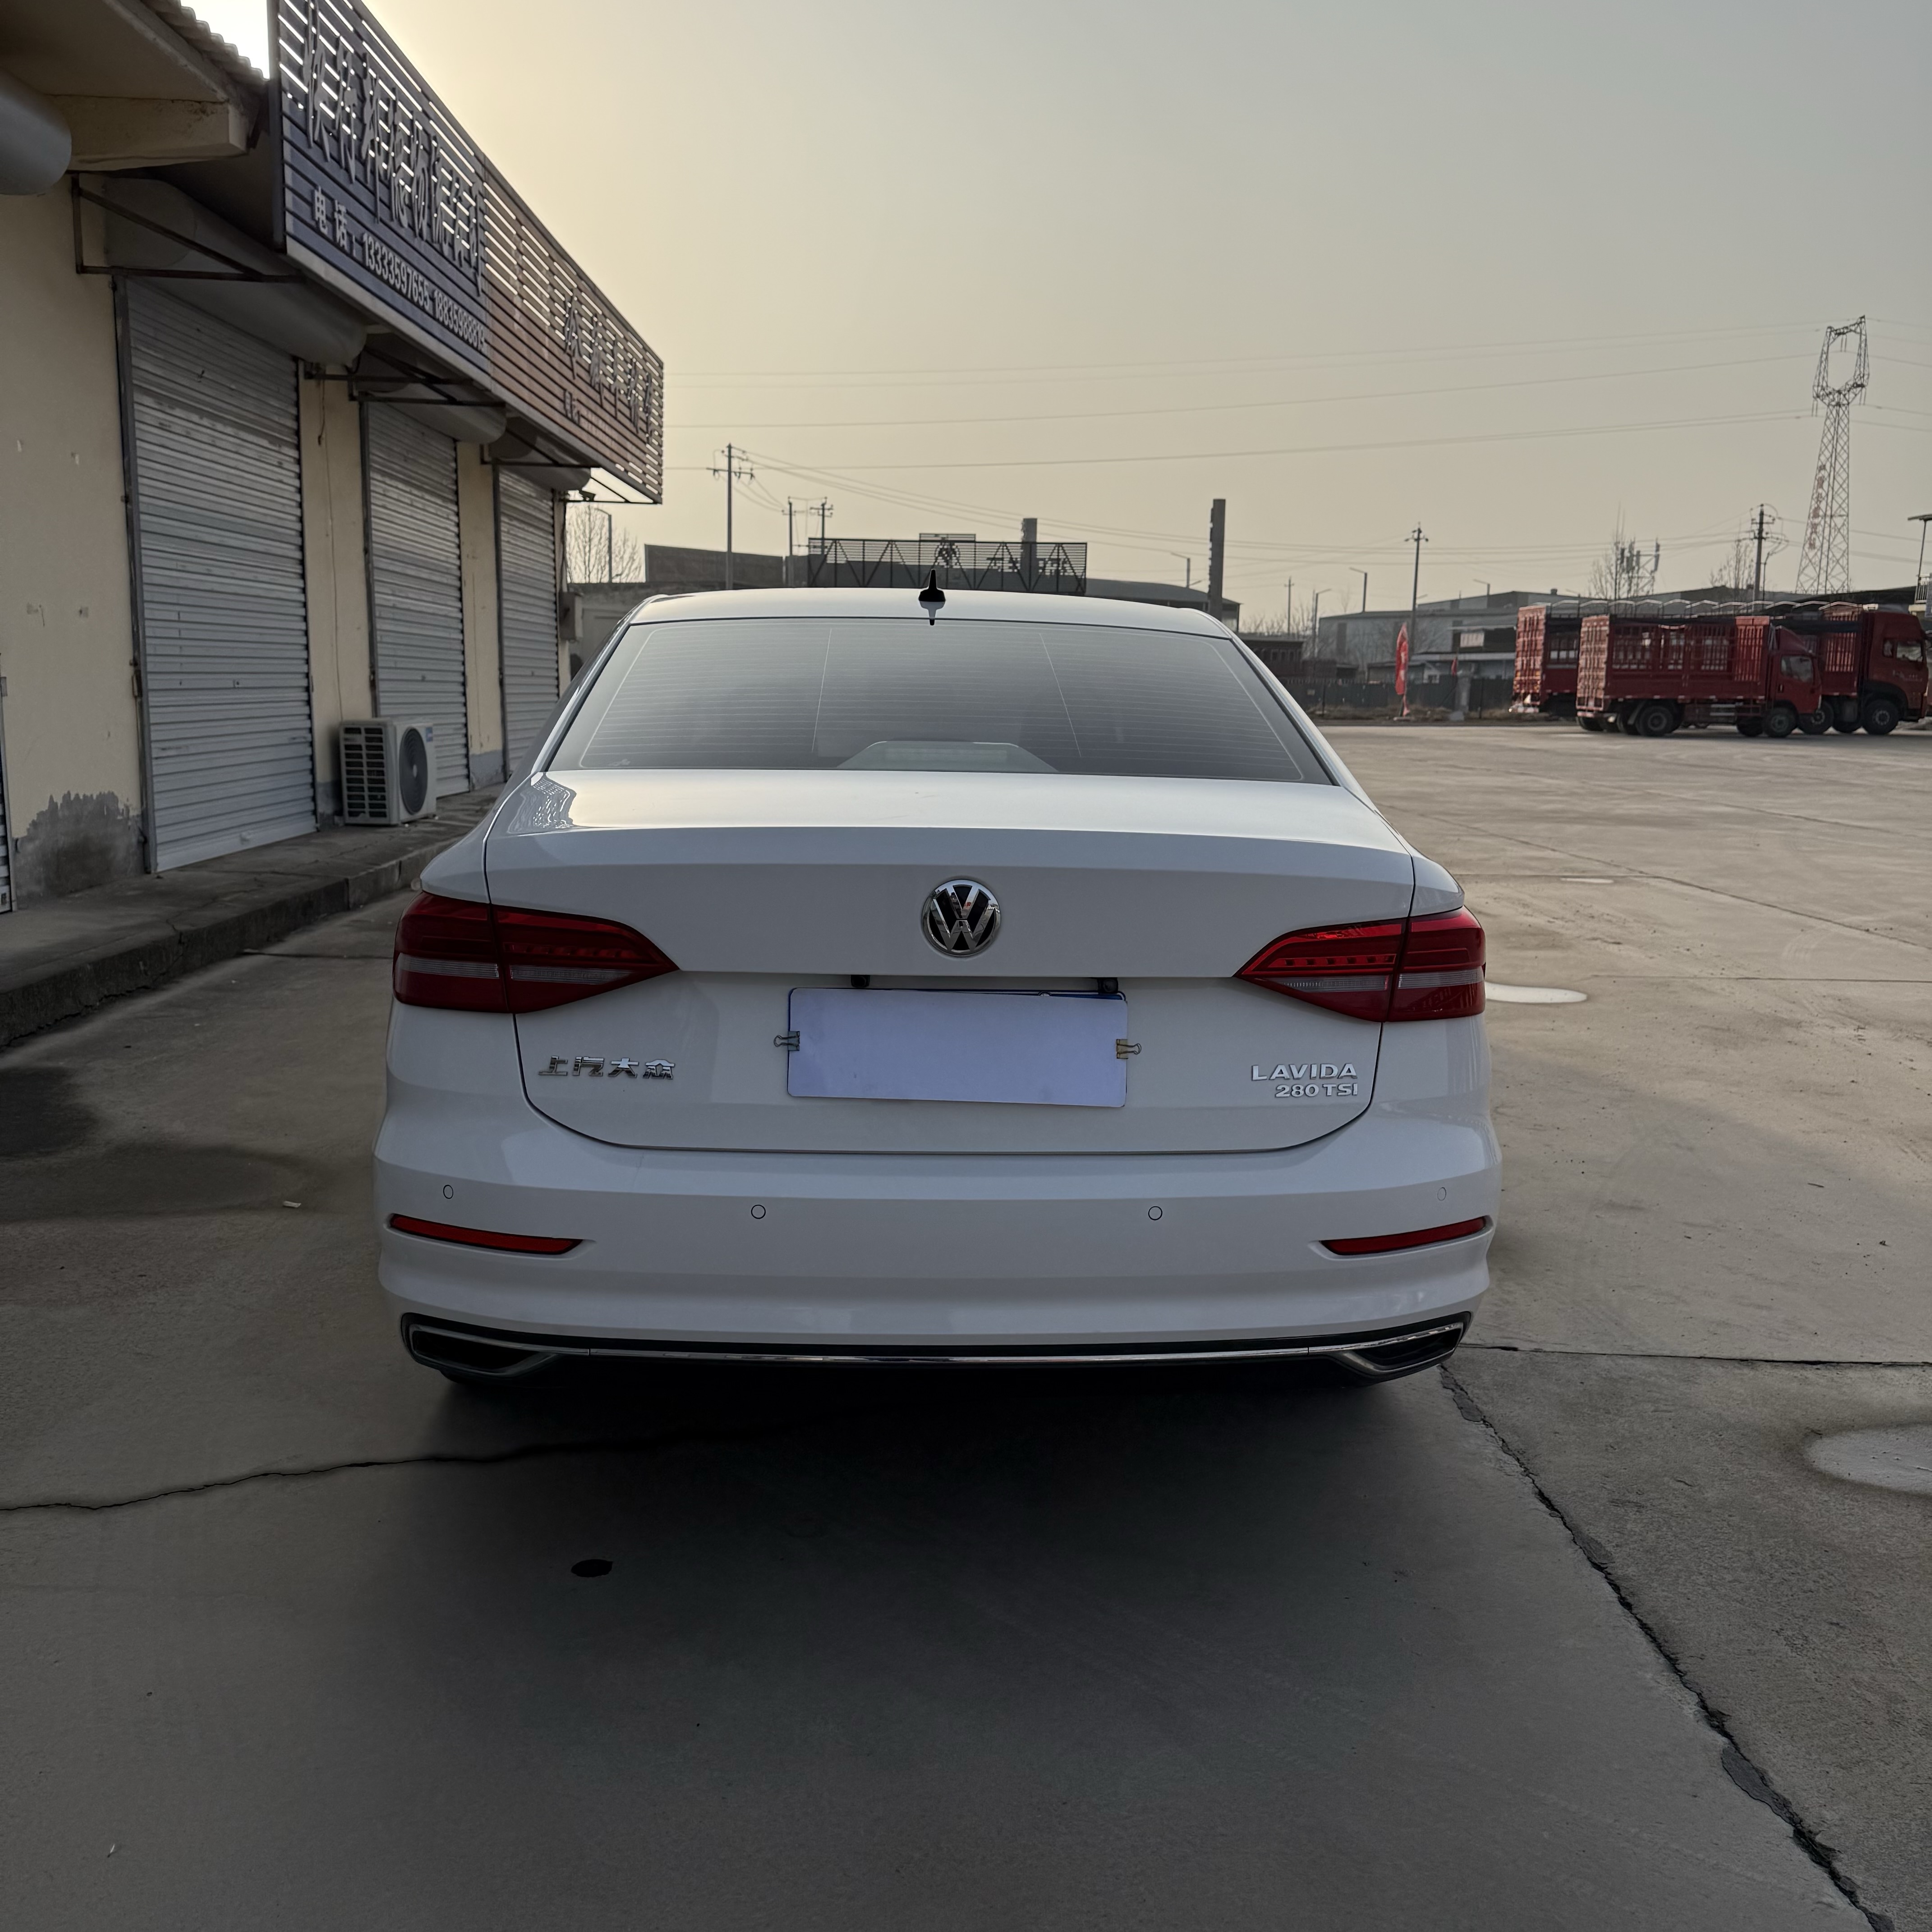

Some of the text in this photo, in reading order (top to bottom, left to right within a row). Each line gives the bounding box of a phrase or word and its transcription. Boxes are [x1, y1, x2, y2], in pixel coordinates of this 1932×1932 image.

[363, 232, 430, 310] 13333597655
[538, 1055, 675, 1079] 上汽大众
[1251, 1063, 1357, 1081] LAVIDA
